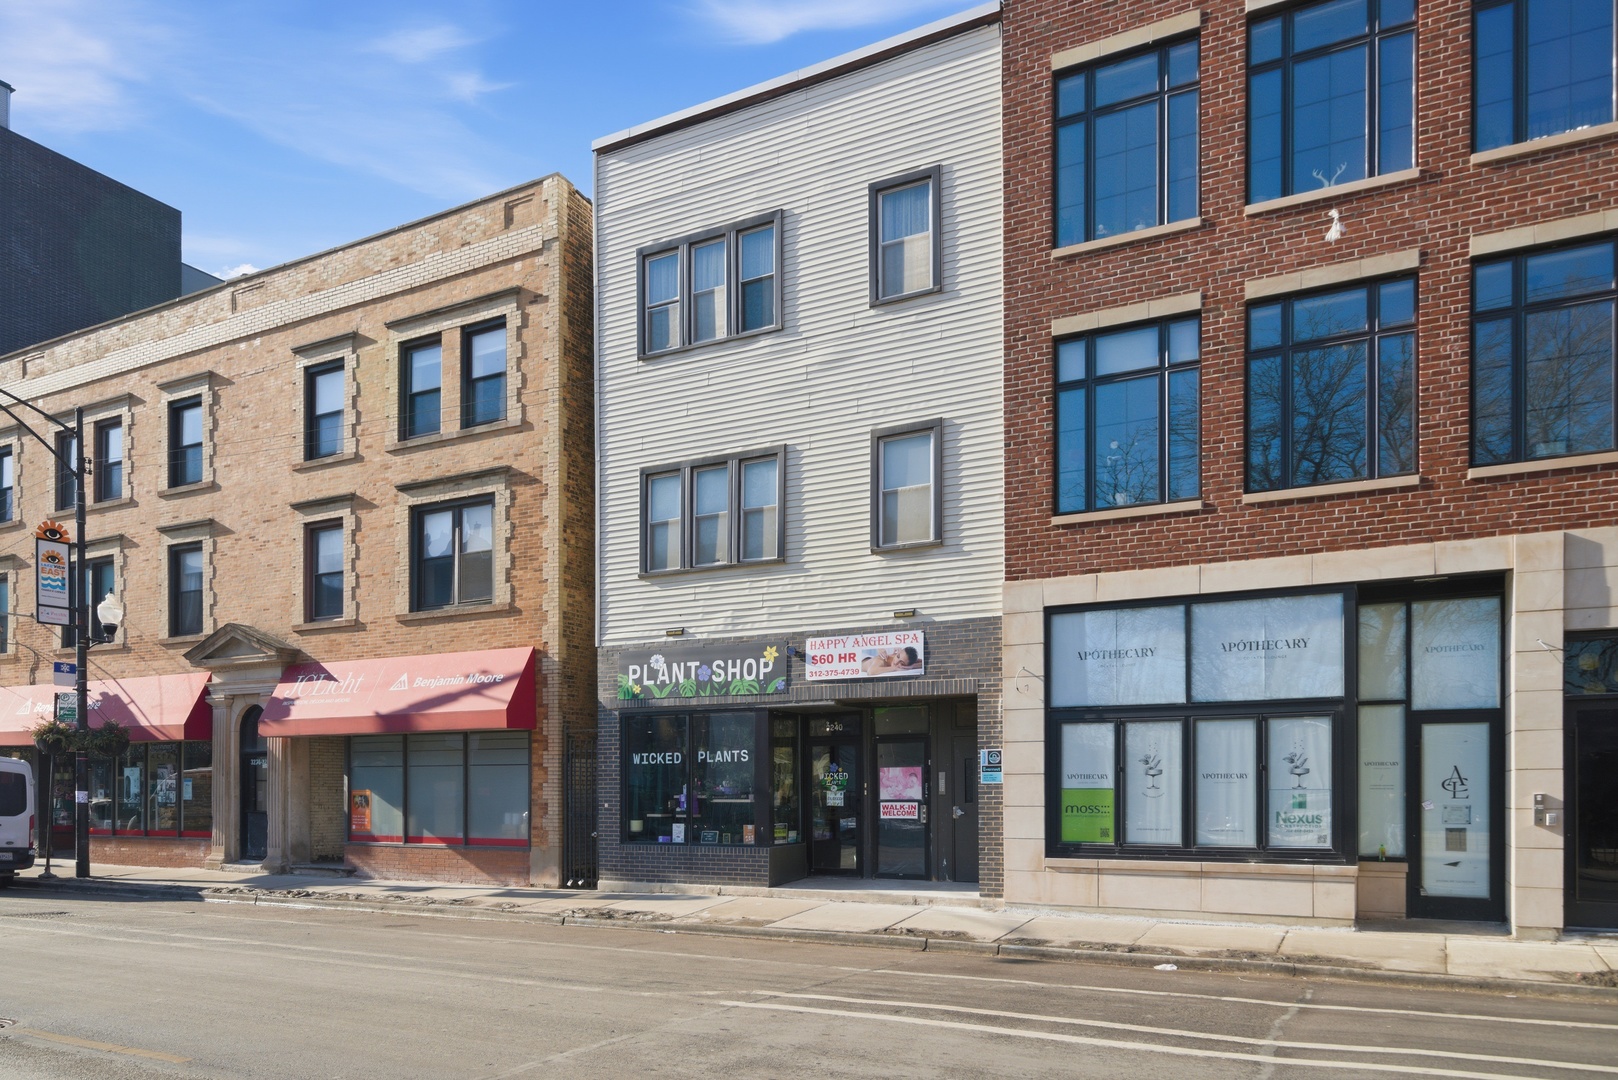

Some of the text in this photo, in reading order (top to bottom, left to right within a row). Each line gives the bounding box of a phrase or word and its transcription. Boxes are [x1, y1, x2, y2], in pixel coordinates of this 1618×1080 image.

[40, 567, 65, 578] EAST
[810, 633, 919, 650] HAPPY ANGEL SPA
[811, 652, 857, 666] $60 HR
[628, 658, 773, 686] PLANT SHOP
[809, 668, 860, 678] 312-375-4739
[412, 673, 504, 689] Benjamin Moore
[632, 750, 749, 765] WICKED PLANTS
[819, 772, 849, 780] WICKED
[1275, 811, 1323, 824] Nexus
